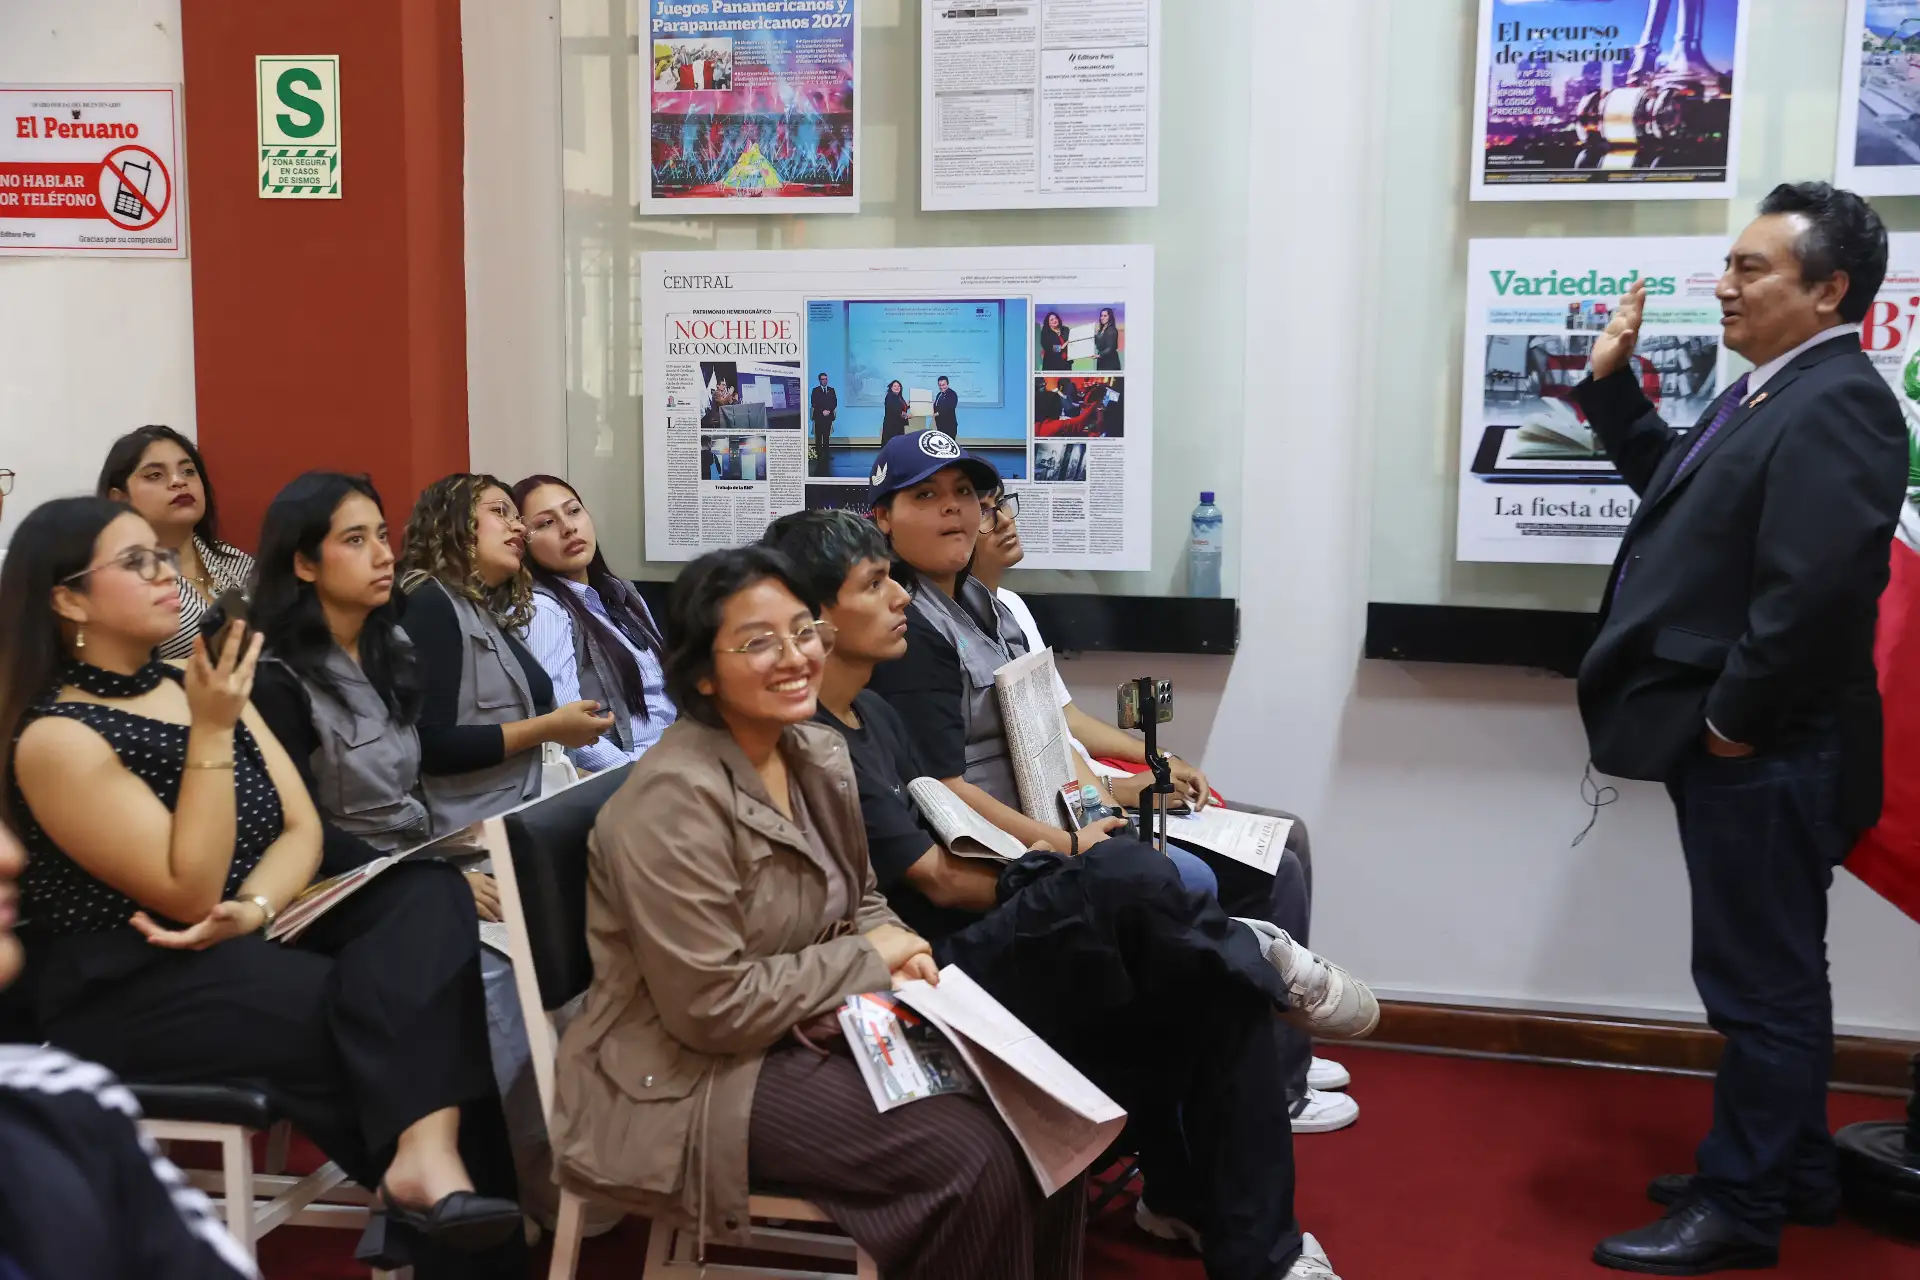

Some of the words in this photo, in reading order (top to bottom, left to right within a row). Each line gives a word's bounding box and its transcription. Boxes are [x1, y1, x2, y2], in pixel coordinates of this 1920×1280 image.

[656, 2, 709, 16] Juegos
[712, 0, 834, 14] Panamericanos
[836, 0, 847, 14] y
[652, 16, 809, 34] Parapanamericanos
[811, 14, 851, 28] 2027
[1497, 21, 1520, 42] El
[1527, 24, 1619, 41] recurso
[1496, 44, 1522, 64] de
[1528, 41, 1631, 63] casación
[276, 68, 324, 138] S
[16, 116, 37, 138] El
[43, 117, 139, 139] Peruano
[0, 175, 20, 188] NO
[23, 175, 85, 188] HABLAR
[22, 191, 96, 206] TELÉFONO
[105, 237, 116, 245] por
[127, 236, 173, 245] comprensión
[663, 276, 733, 289] CENTRAL
[1490, 269, 1676, 297] Variedades
[674, 320, 757, 340] NOCHE
[762, 320, 792, 340] DE
[668, 342, 798, 355] RECONOCIMIENTO
[1494, 497, 1523, 516] La
[1532, 497, 1591, 516] fiesta
[1600, 499, 1634, 518] del
